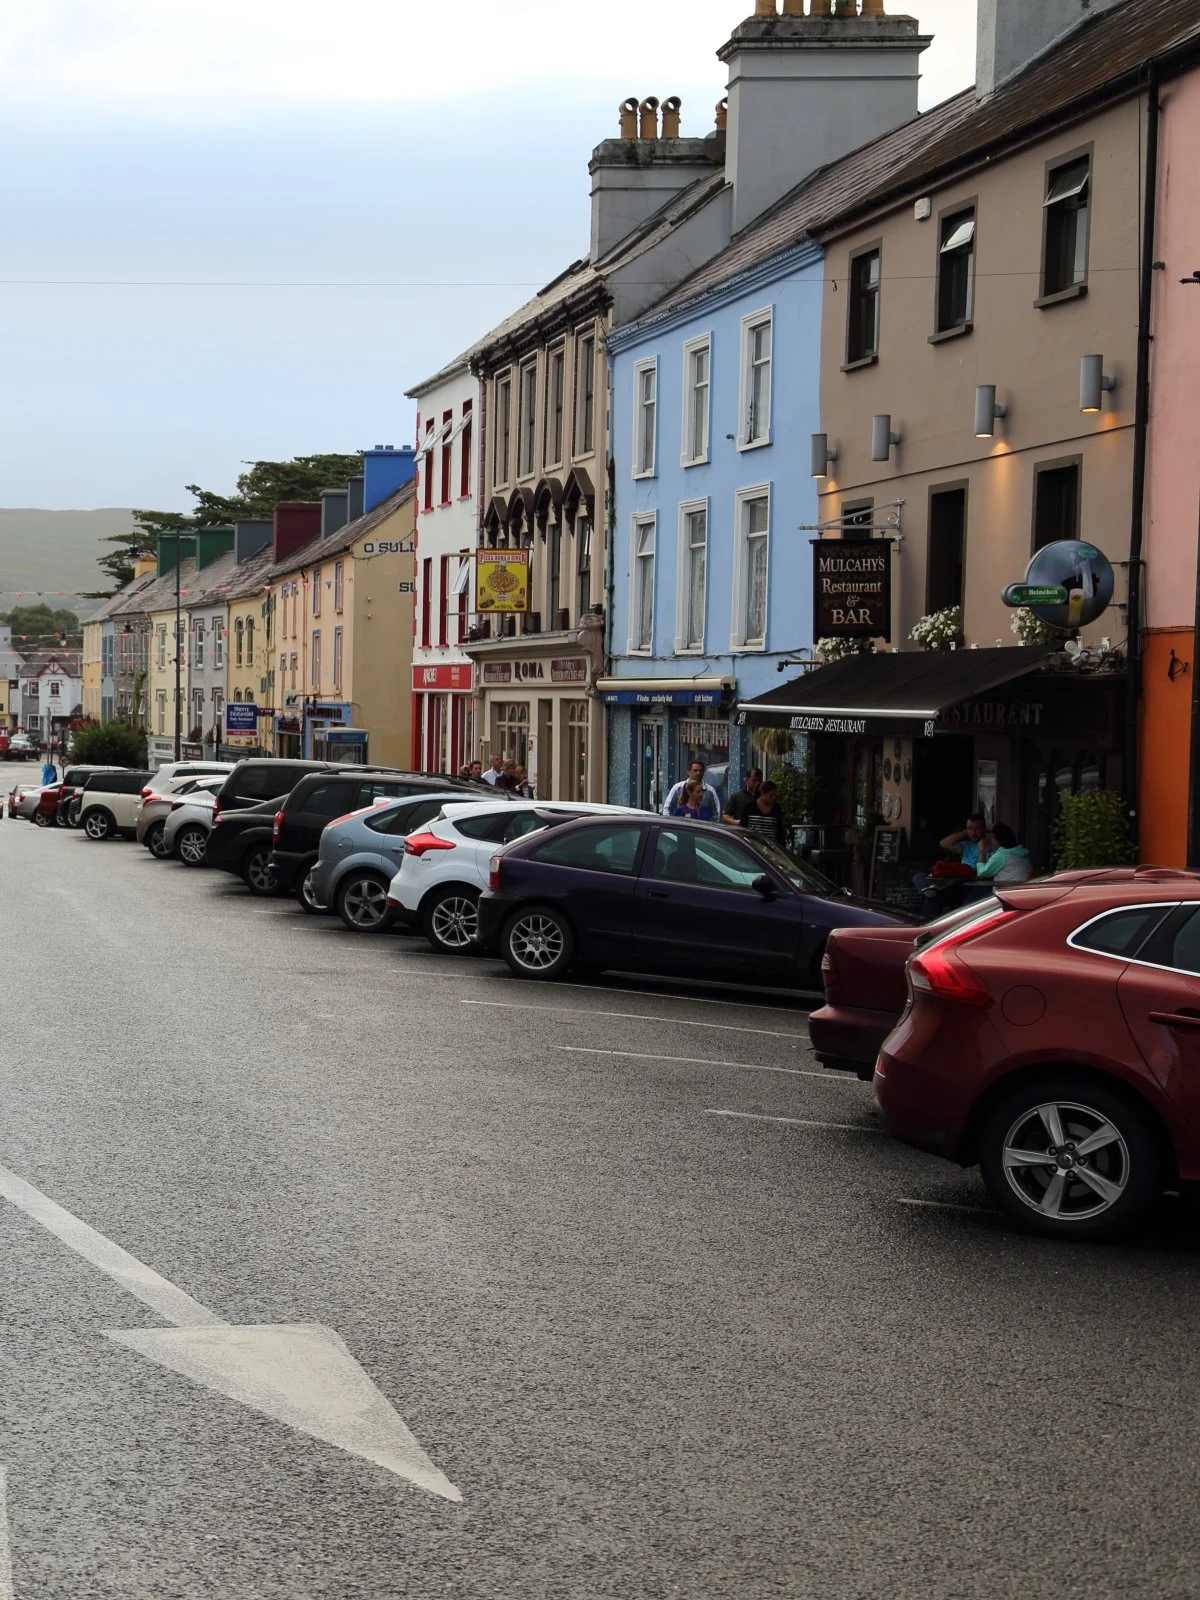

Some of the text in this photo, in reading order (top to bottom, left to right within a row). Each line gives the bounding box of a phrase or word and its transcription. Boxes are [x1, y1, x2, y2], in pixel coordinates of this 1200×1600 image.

[821, 578, 882, 594] Restaurant
[846, 595, 859, 607] &
[831, 609, 874, 625] BAR
[514, 662, 544, 682] ROMA
